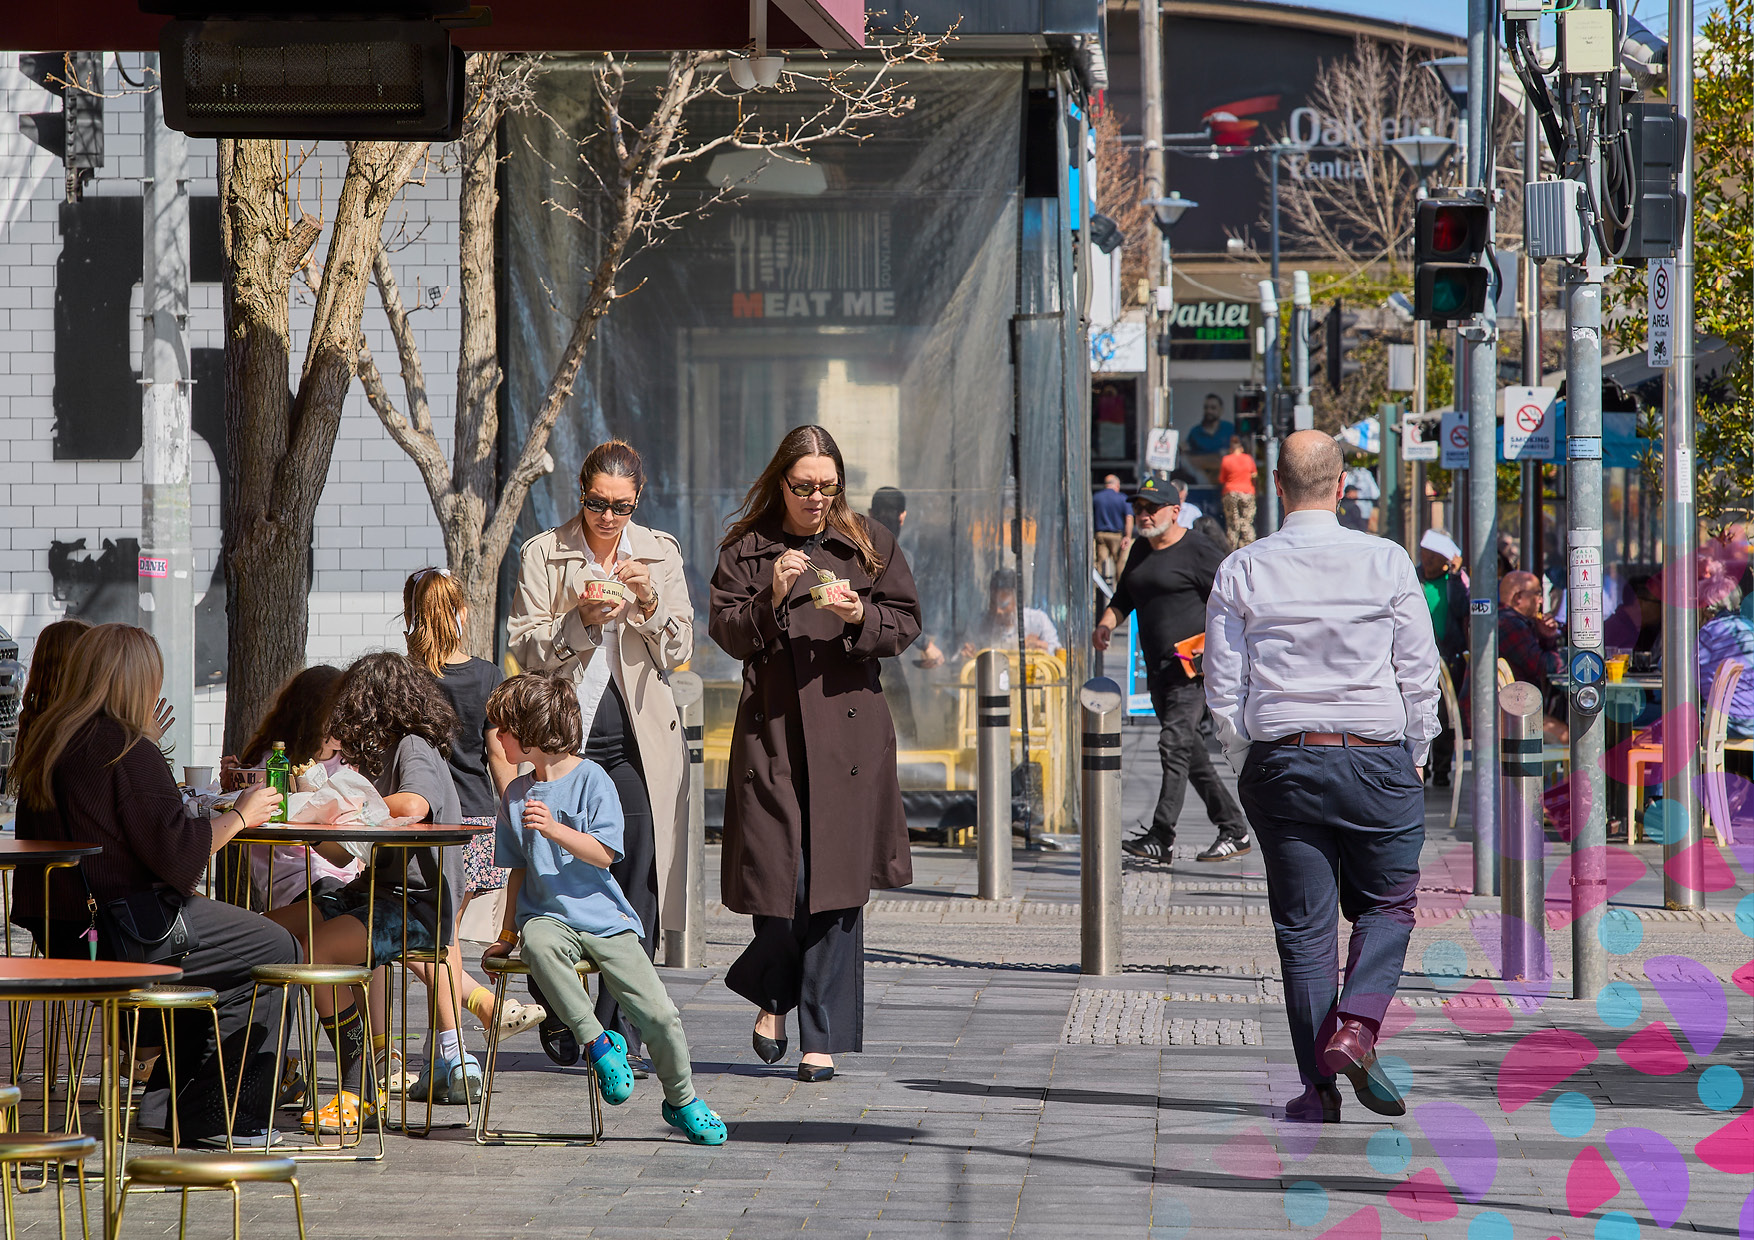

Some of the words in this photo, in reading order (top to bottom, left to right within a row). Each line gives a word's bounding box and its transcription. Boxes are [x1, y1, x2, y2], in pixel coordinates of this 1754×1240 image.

[1290, 153, 1371, 181] Centra
[733, 292, 831, 318] MEAT
[843, 290, 896, 317] ME
[1652, 314, 1669, 328] AREA
[140, 560, 165, 571] DANK
